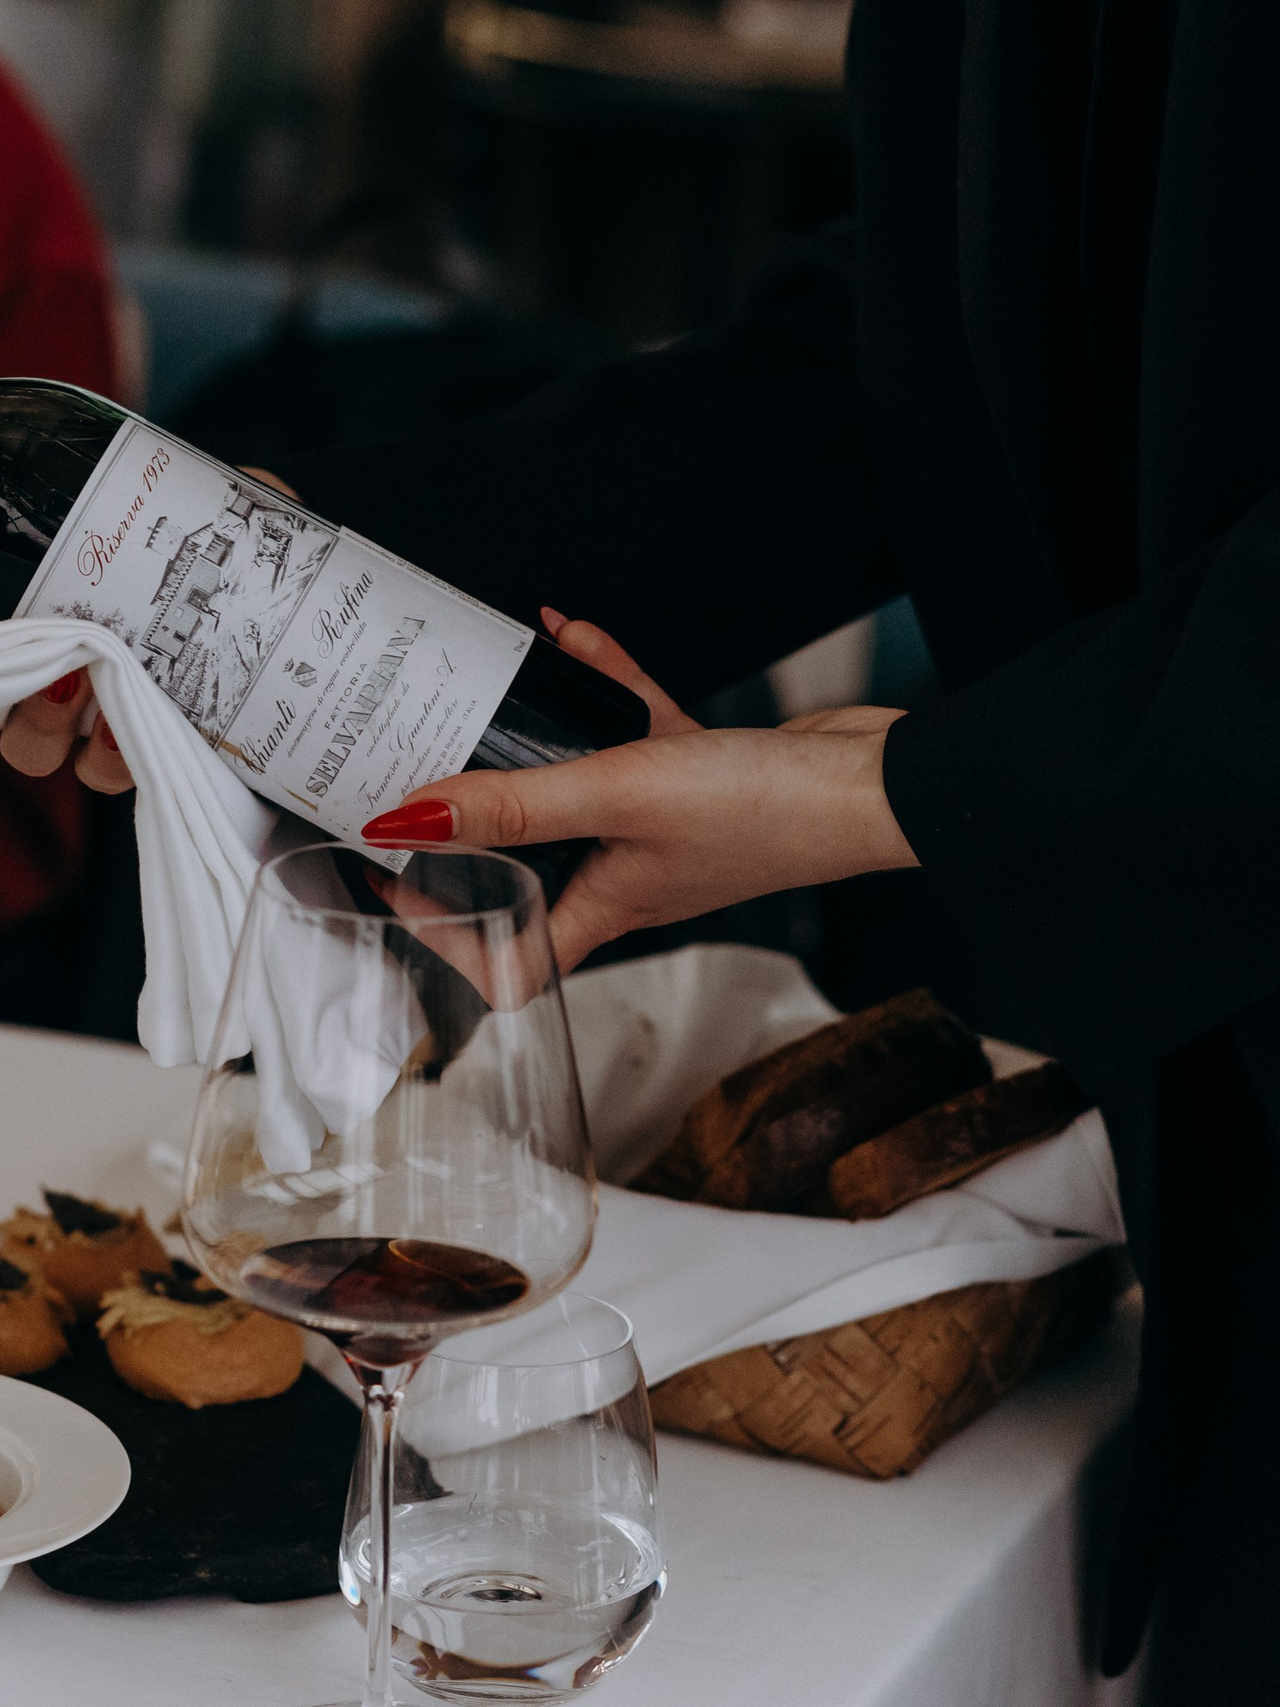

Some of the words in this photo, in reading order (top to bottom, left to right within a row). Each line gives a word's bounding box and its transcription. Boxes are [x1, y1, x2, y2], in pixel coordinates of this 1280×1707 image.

[76, 493, 145, 587] Riserva
[141, 446, 171, 493] 1973
[232, 698, 299, 777] Chianti
[312, 567, 374, 659] Rufina
[305, 614, 426, 799] SELVAPIANA
[316, 696, 325, 706] di
[323, 662, 367, 730] FATTORIA
[398, 680, 411, 696] da
[355, 755, 402, 815] Francesco
[389, 688, 442, 759] Giuntini
[444, 725, 462, 750] RUFINA
[461, 699, 477, 720] ITALIA
